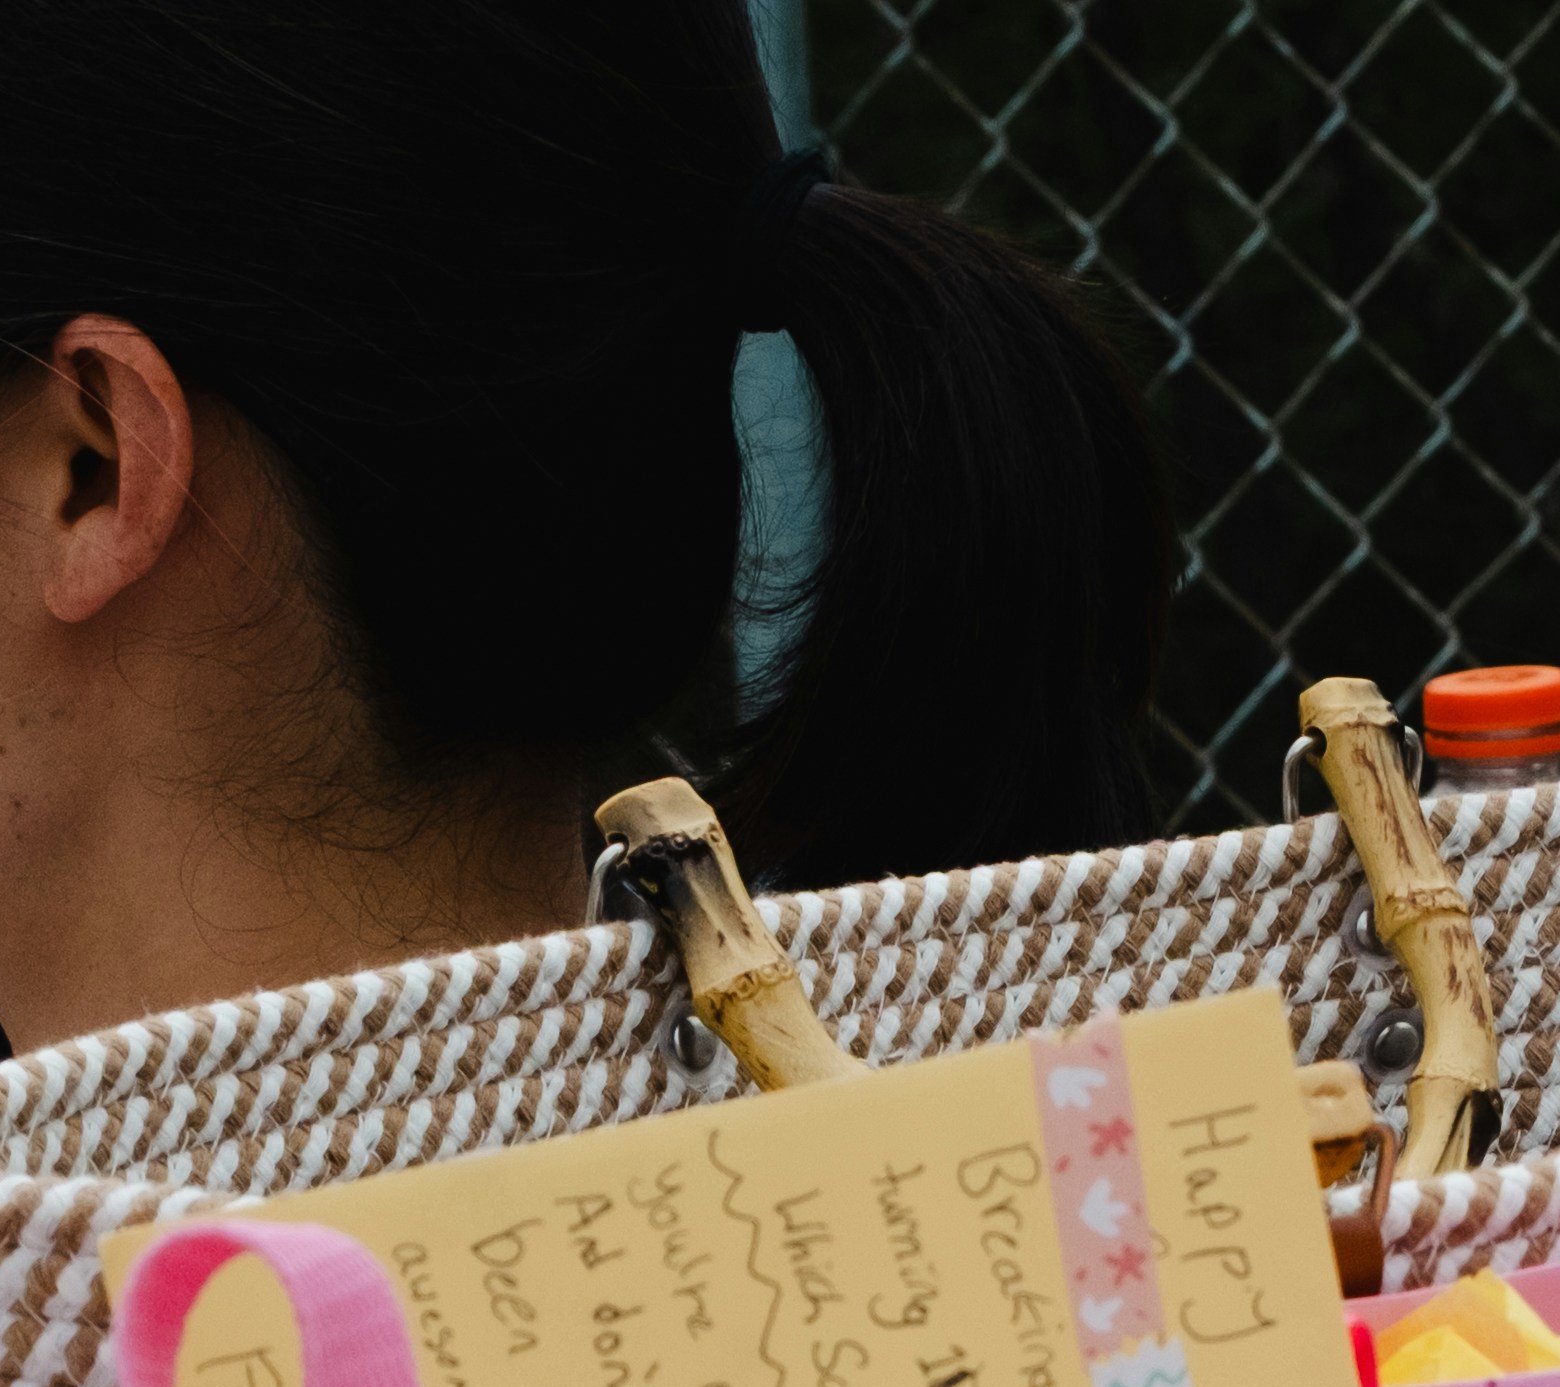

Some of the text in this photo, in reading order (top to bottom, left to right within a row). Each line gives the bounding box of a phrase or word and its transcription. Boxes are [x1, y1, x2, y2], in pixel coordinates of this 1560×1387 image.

[470, 1215, 544, 1356] been
[554, 1192, 628, 1272] And
[866, 1160, 942, 1329] turning
[1168, 1103, 1278, 1345] Happy
